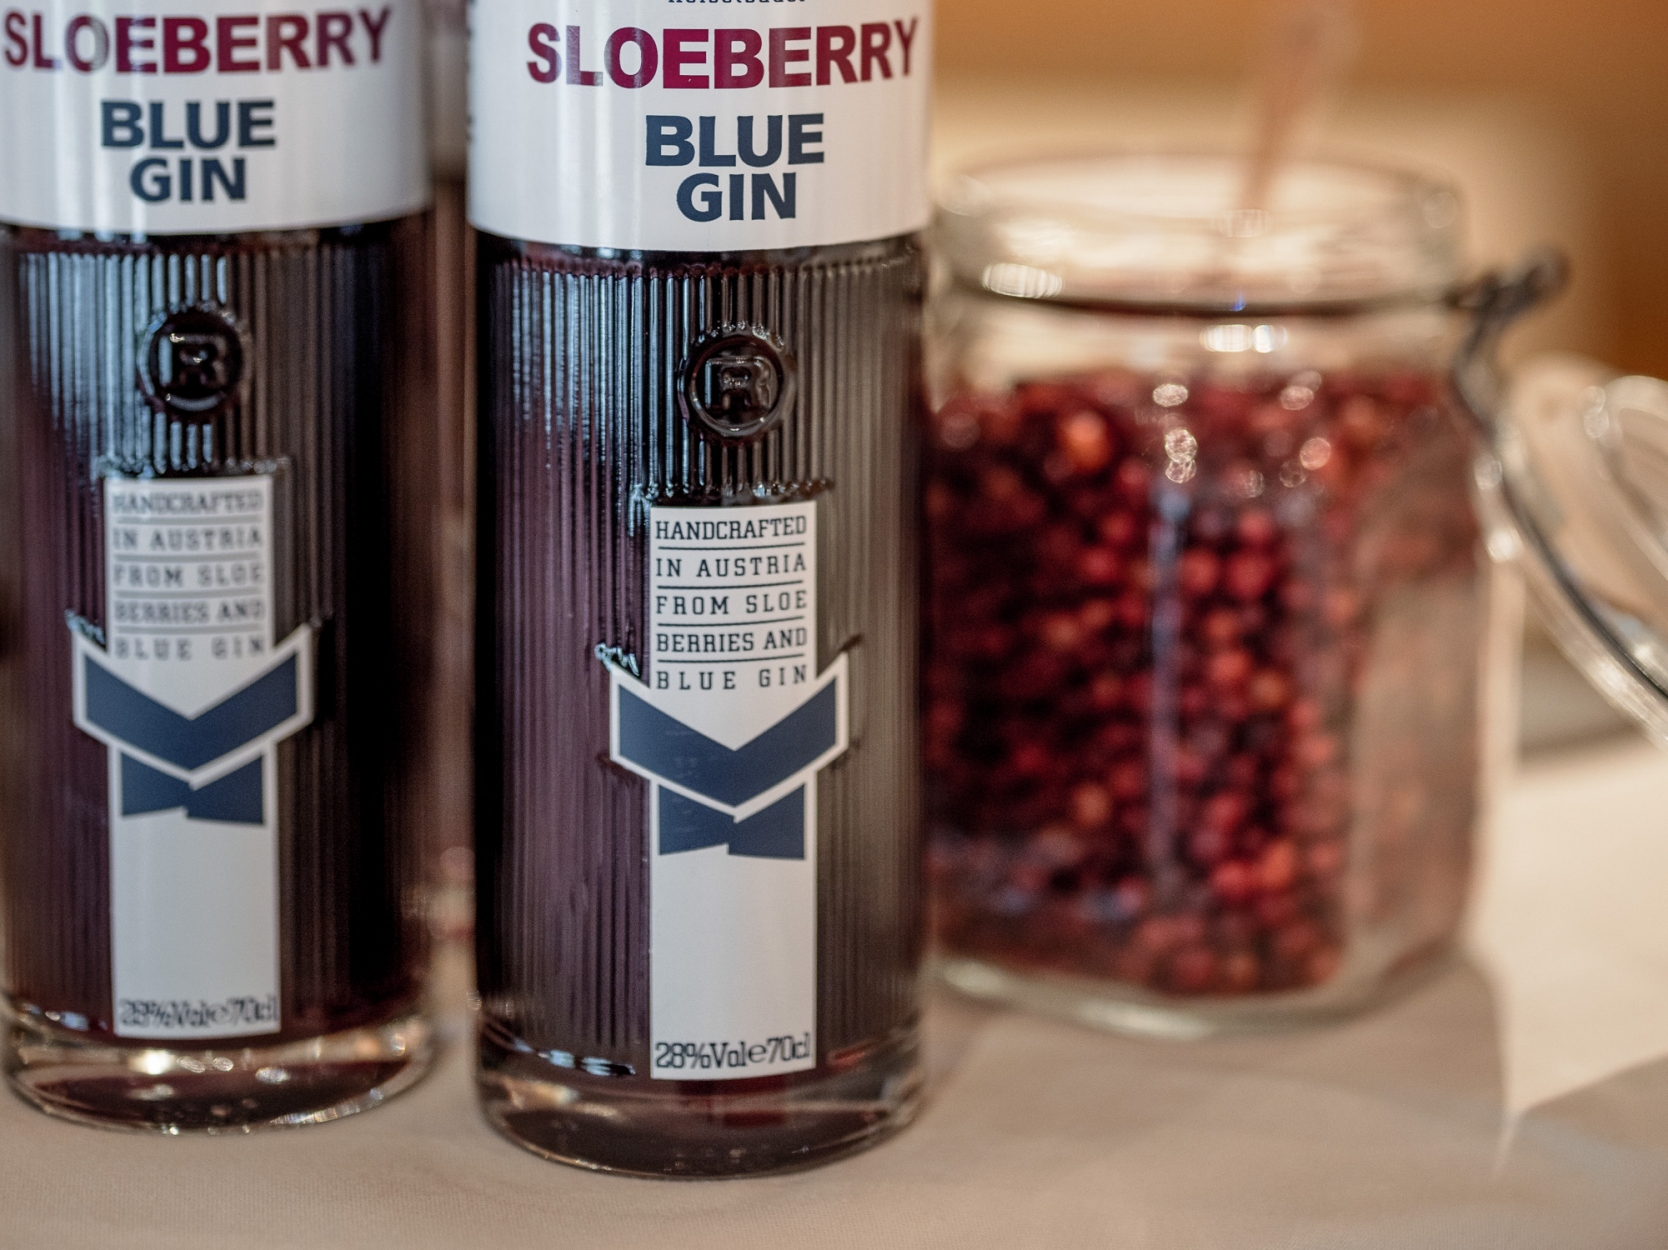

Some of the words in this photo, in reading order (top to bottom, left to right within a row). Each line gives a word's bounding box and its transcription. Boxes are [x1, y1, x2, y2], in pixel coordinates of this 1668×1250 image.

[4, 4, 392, 74] SLOEBERRY
[526, 16, 919, 90] SLOEBERRY
[101, 99, 276, 150] BLUE
[645, 112, 825, 168] BLUE
[129, 157, 247, 203] GIN
[676, 171, 797, 223] GIN
[112, 529, 138, 549] IN
[151, 528, 263, 551] AUSTRIA
[655, 515, 807, 541] HANDCRAFTED
[113, 564, 184, 588] FROM
[198, 564, 265, 586] SLOE
[656, 558, 682, 578] IN
[696, 553, 807, 578] AUSTRIA
[114, 601, 210, 624] BERRIES
[656, 596, 730, 616] FROM
[745, 590, 808, 615] SLOE
[114, 636, 193, 661] BLUE
[211, 635, 265, 659] GIN
[656, 632, 755, 654] BERRIES
[763, 627, 808, 651] AND
[656, 670, 737, 692] BLUE
[758, 664, 808, 688] GIN
